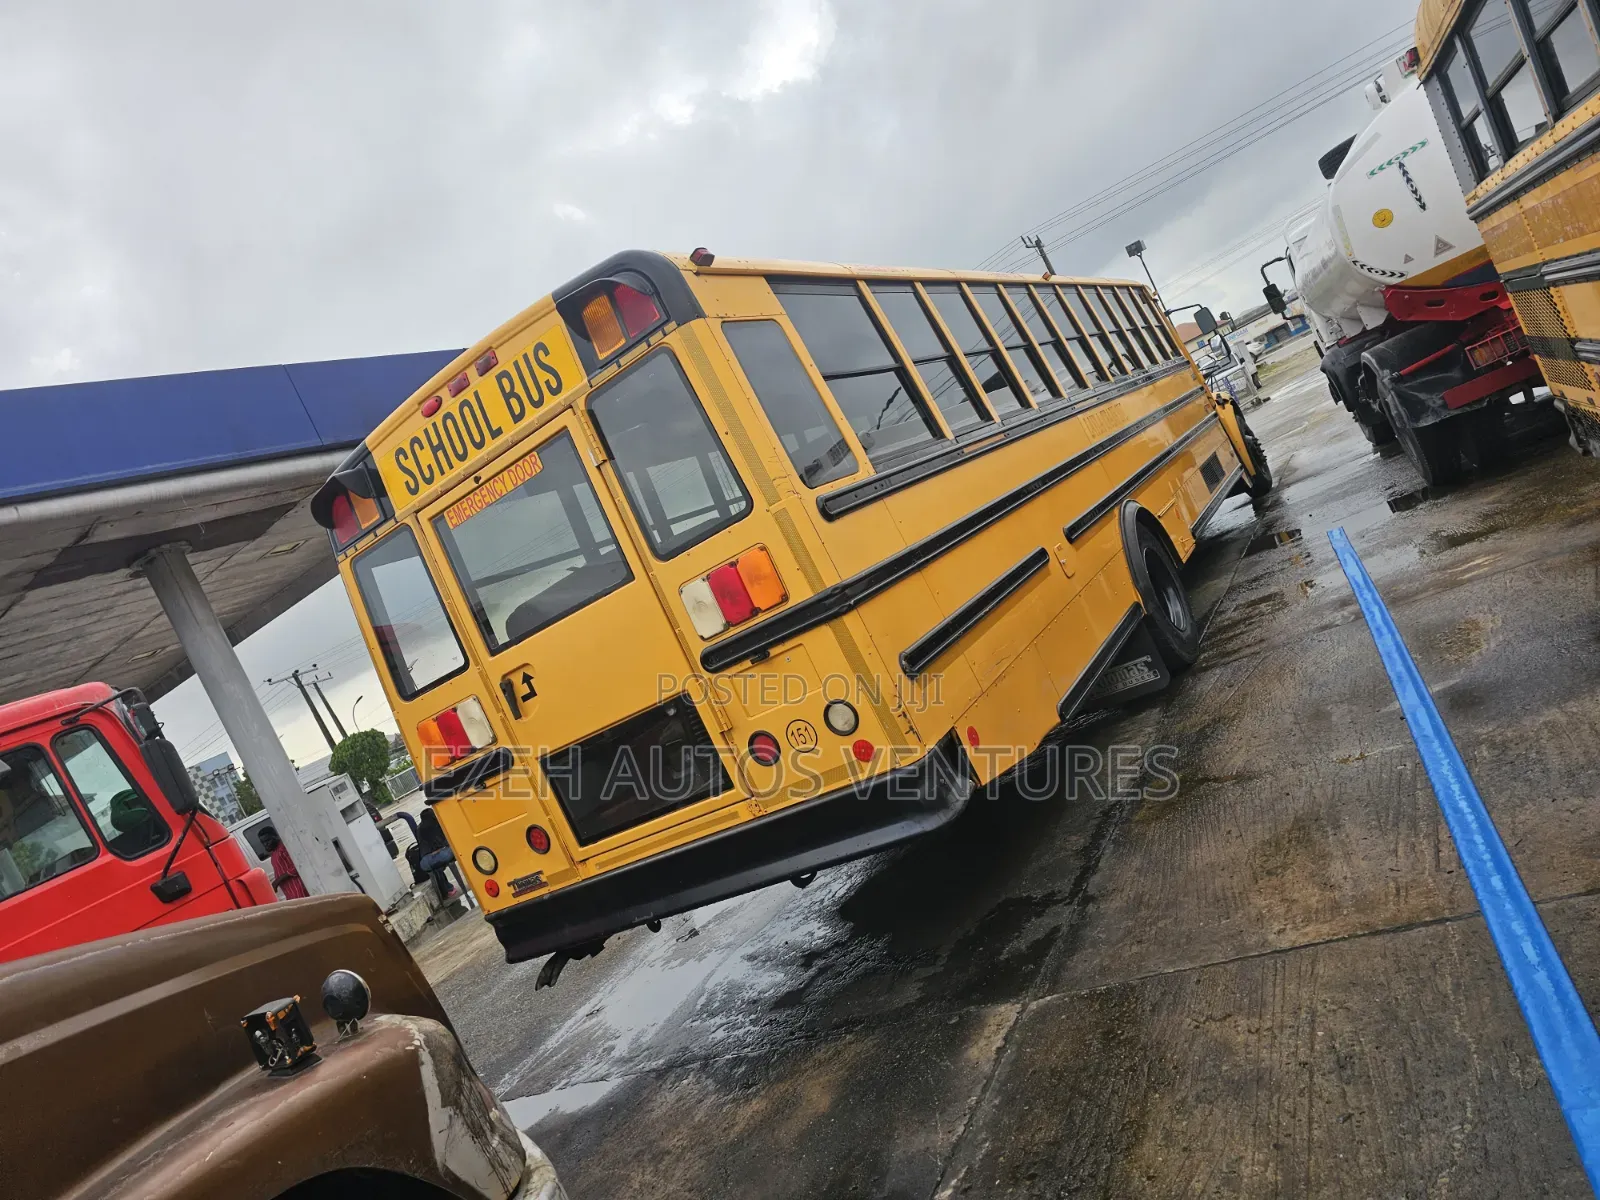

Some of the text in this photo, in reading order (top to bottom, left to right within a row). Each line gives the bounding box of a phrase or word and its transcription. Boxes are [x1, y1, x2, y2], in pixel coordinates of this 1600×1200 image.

[394, 341, 563, 496] SCHOOL BUS
[445, 453, 542, 529] EMERGENCY DOOR
[790, 725, 814, 747] 151
